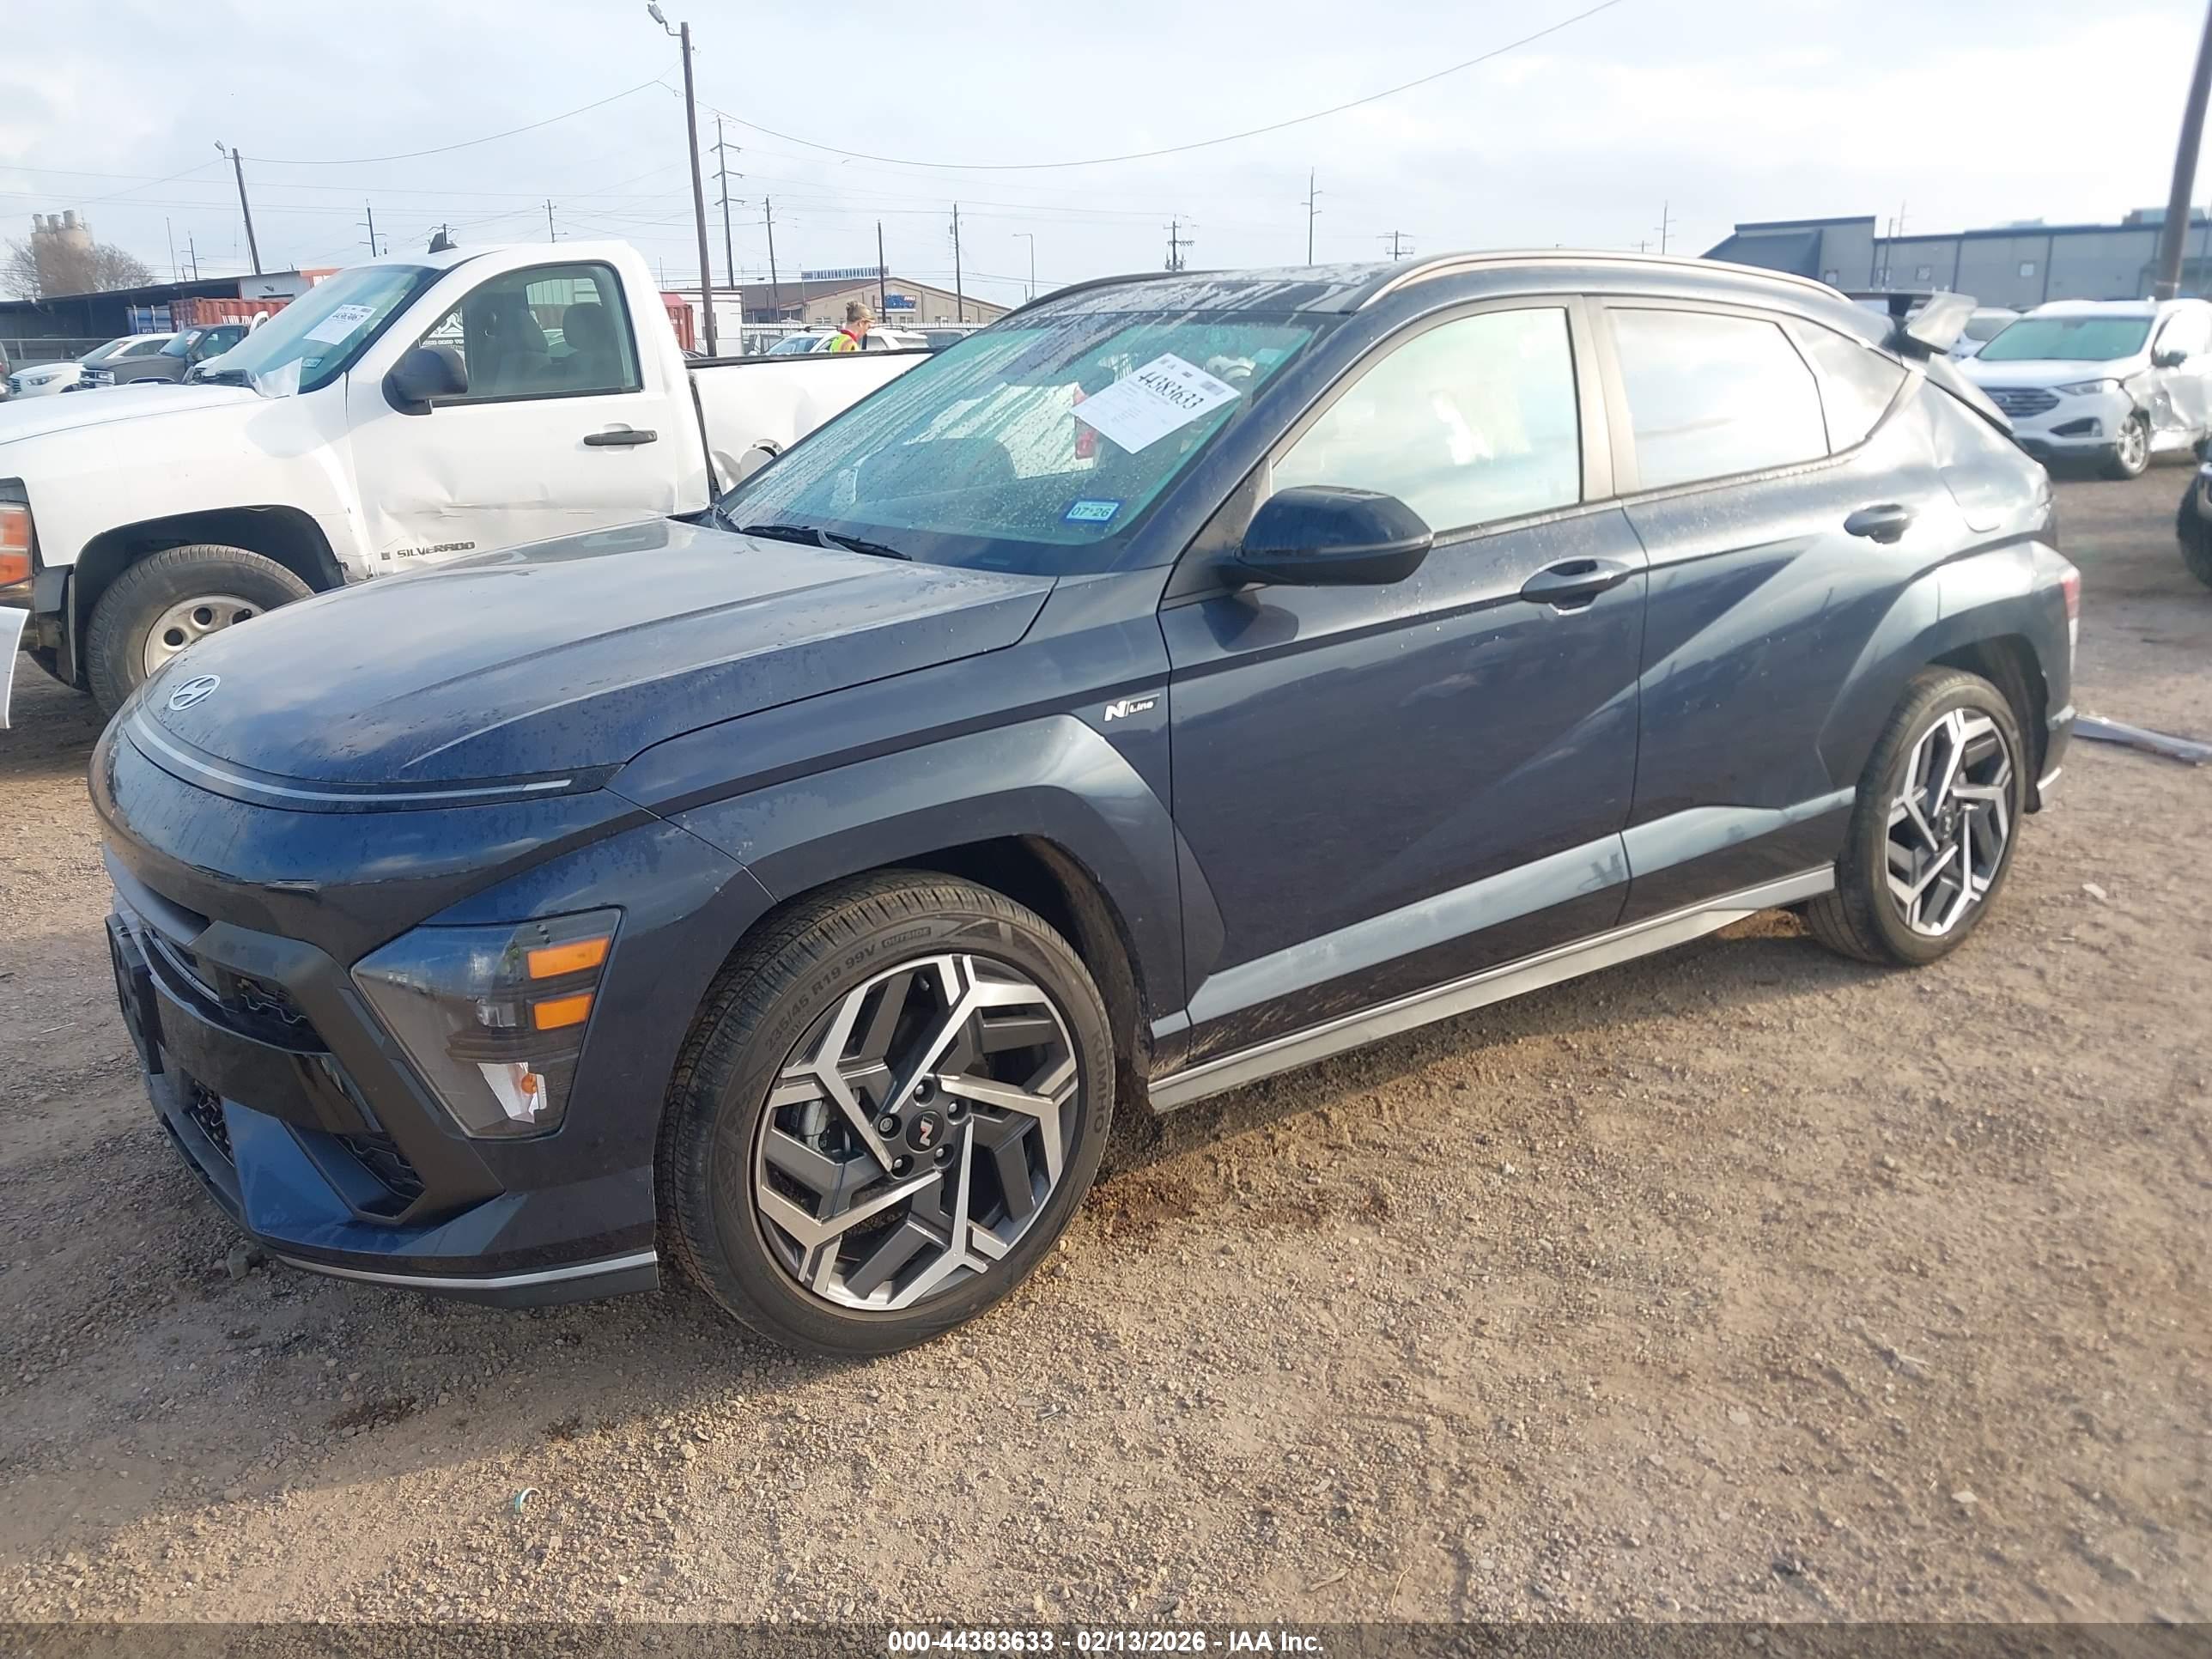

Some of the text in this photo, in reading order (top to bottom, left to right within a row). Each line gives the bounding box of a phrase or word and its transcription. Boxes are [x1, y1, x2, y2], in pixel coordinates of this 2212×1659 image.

[1138, 371, 1204, 409] 44383633
[397, 541, 476, 558] SILVERADO
[883, 927, 930, 948] OUTSIDE
[764, 994, 810, 1053] 235/45
[811, 968, 842, 995] R19
[845, 945, 876, 969] 99V
[1091, 1030, 1108, 1133] KUMHO
